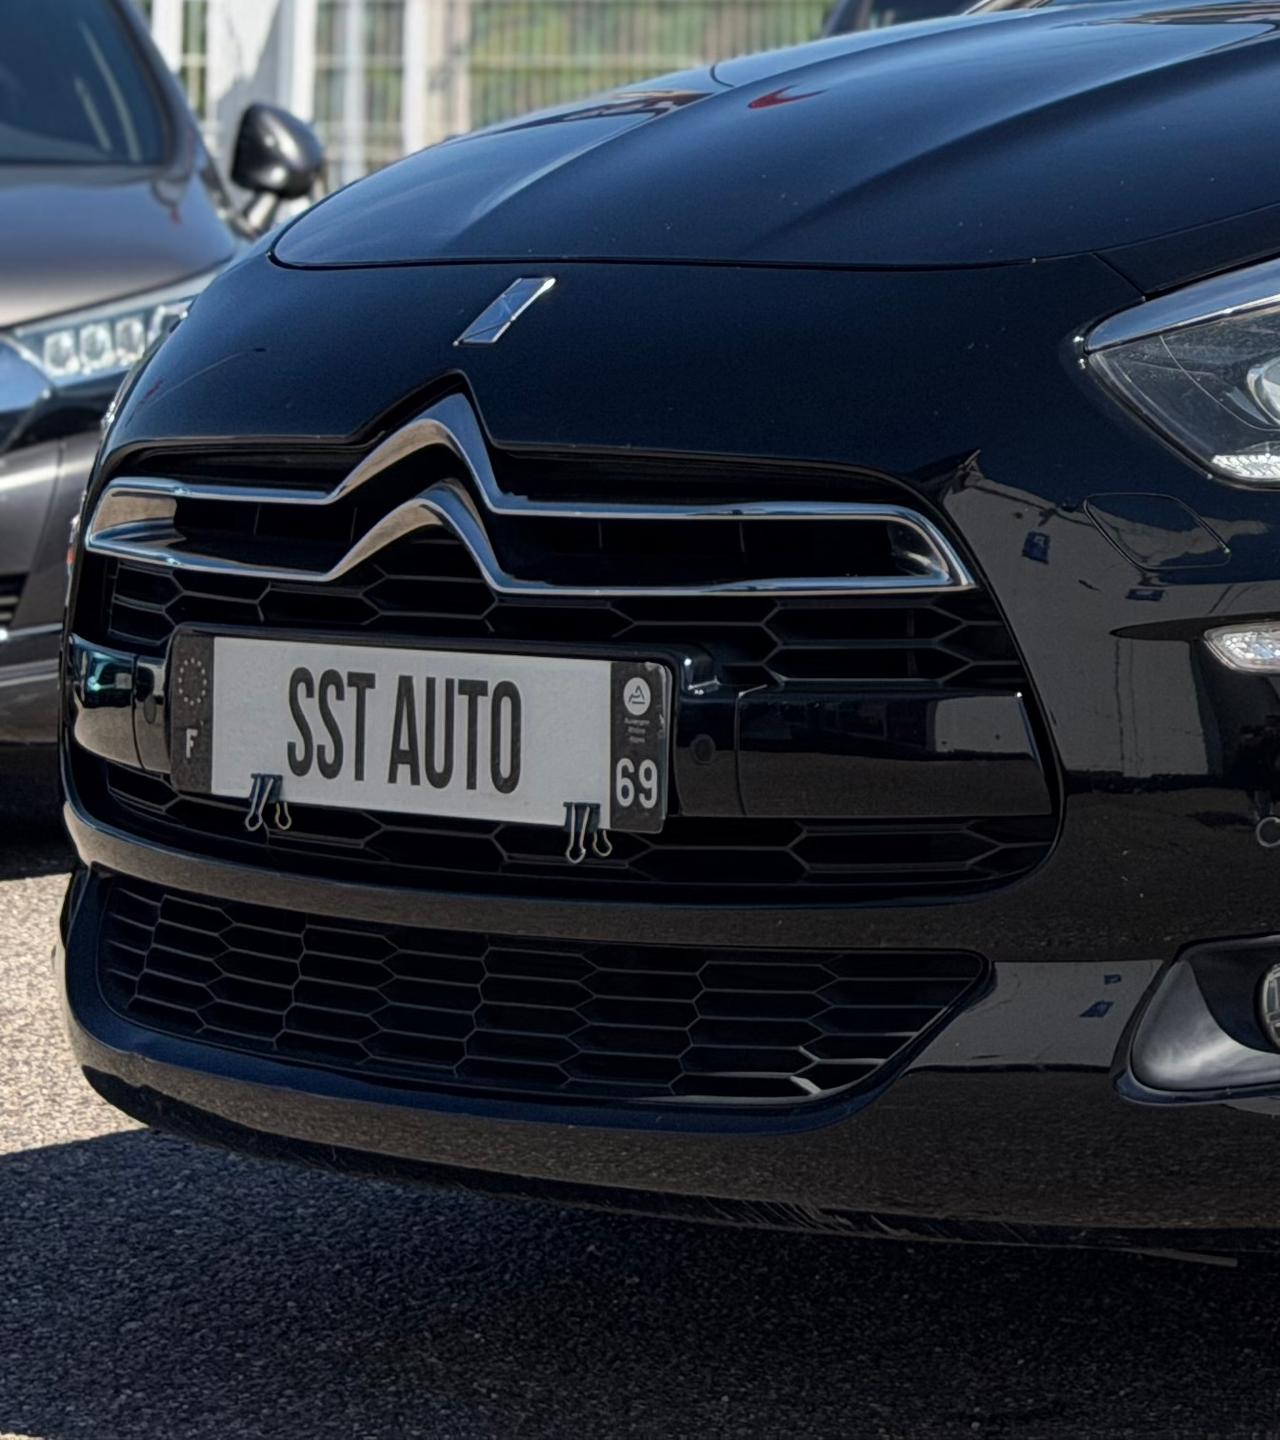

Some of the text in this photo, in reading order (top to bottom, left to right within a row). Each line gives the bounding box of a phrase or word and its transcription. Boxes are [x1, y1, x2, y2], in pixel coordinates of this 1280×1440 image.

[185, 728, 197, 759] F
[287, 667, 521, 794] SST AUTO
[616, 758, 658, 809] 69
